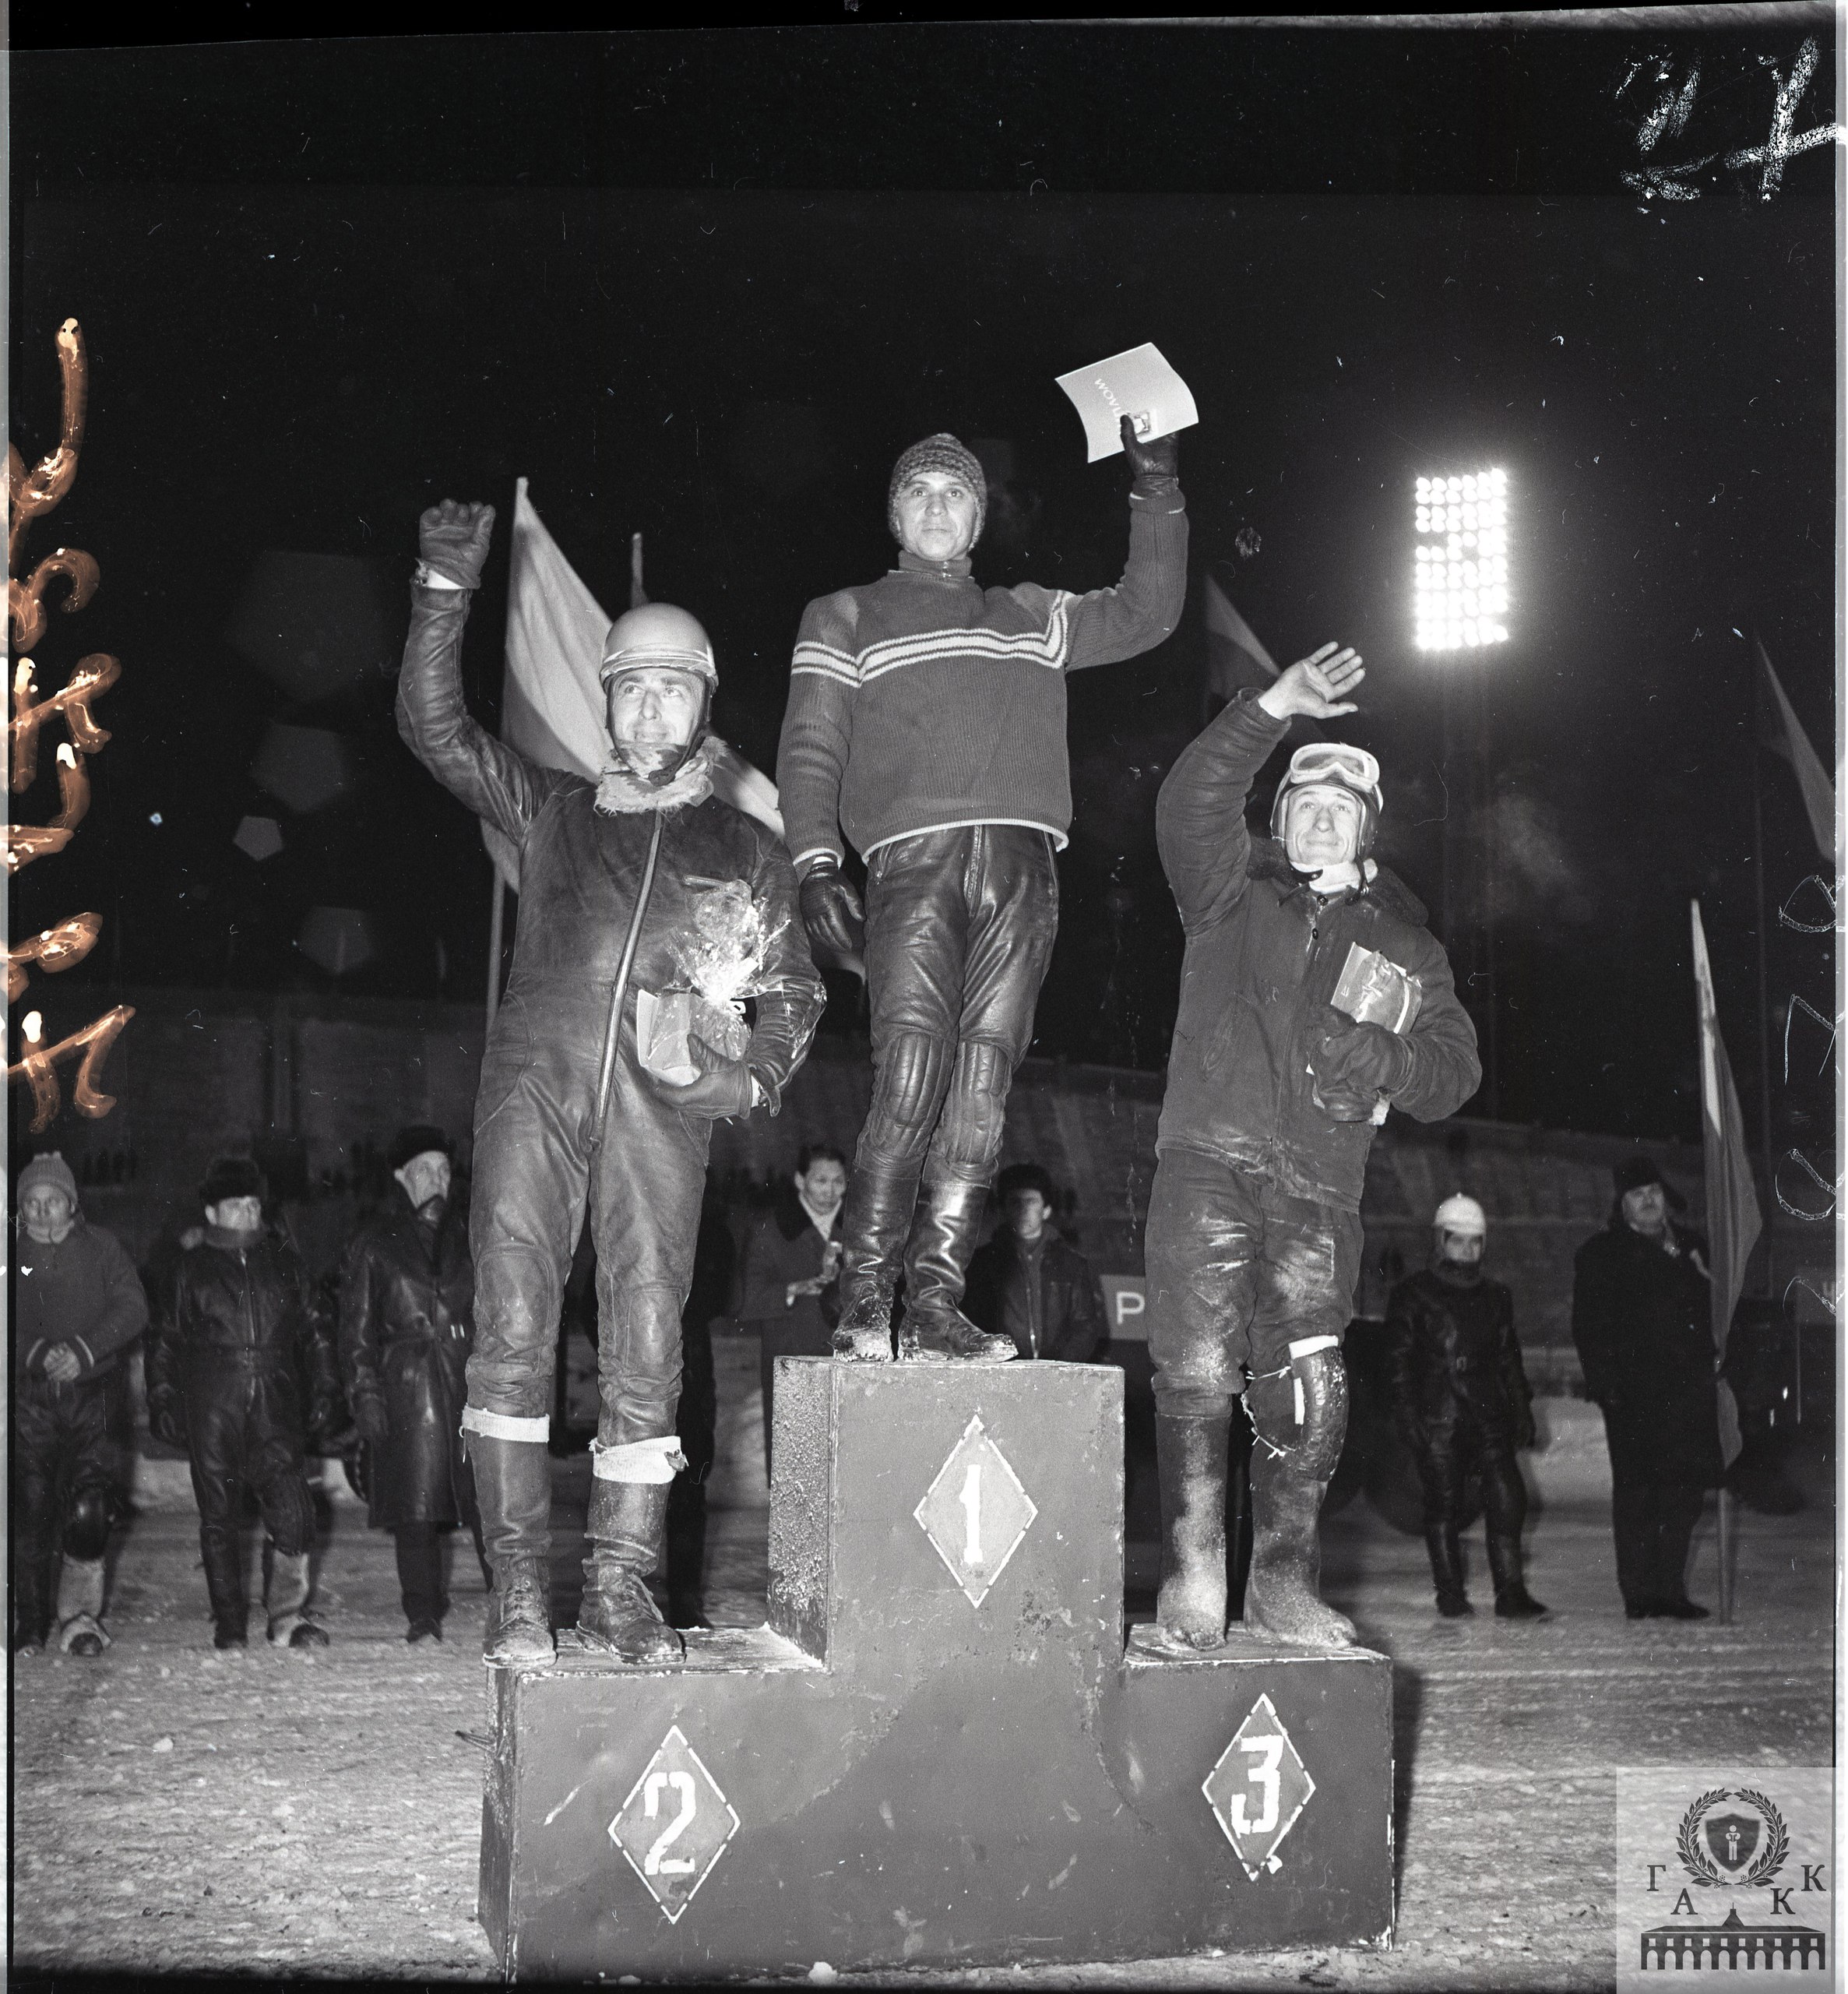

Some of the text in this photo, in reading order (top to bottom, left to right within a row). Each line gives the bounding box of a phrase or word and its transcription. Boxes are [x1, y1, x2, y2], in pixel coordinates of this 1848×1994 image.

[959, 1464, 983, 1564] 1
[644, 1770, 696, 1876] 2
[1231, 1734, 1284, 1839] 3
